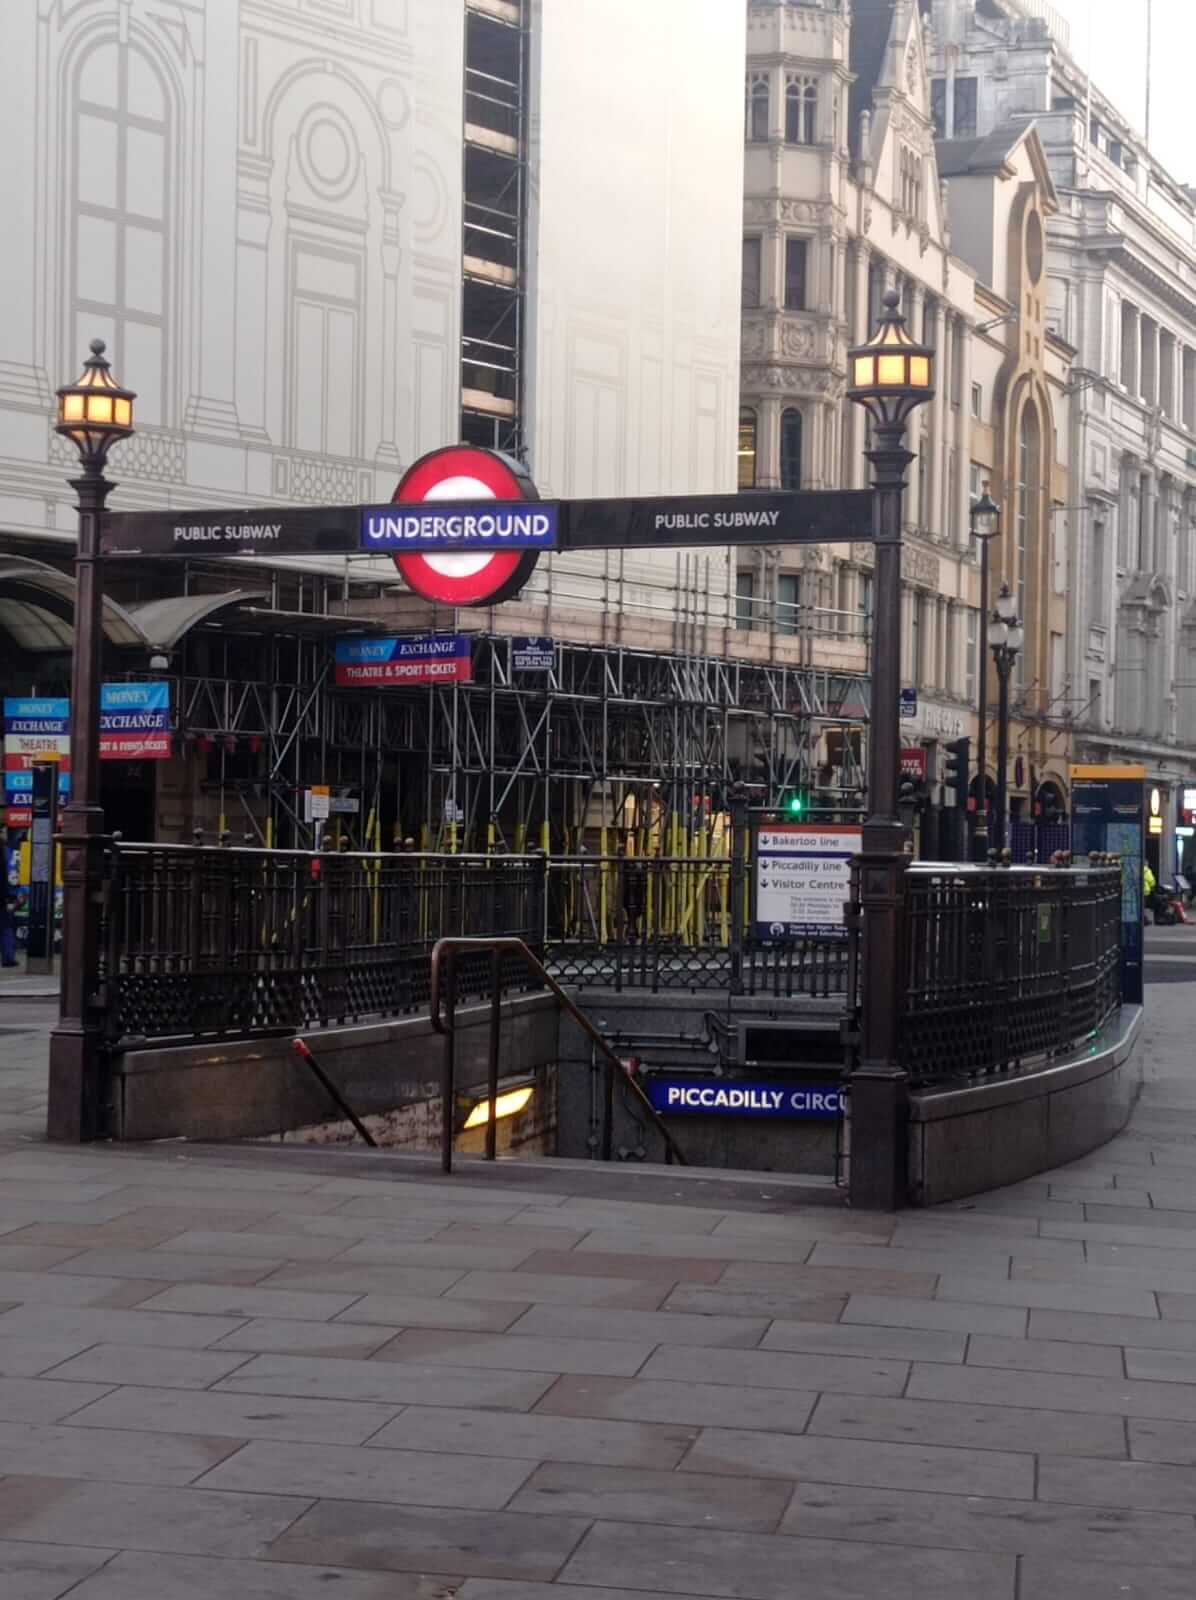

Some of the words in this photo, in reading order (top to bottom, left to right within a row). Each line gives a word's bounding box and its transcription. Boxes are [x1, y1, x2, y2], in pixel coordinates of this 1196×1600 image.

[368, 514, 550, 538] UNDERGROUND
[655, 513, 710, 529] PUBLIC
[713, 511, 780, 527] SUBWAY
[173, 526, 222, 541] PUBLIC
[225, 524, 281, 540] SUBWAY
[400, 642, 456, 655] EXCHANGE
[346, 667, 383, 678] THEATRE
[385, 667, 392, 677] &
[394, 665, 422, 677] SPORT
[425, 663, 456, 675] TICKETS
[106, 690, 148, 704] MONEY
[12, 720, 63, 731] EXCHANGE
[772, 836, 817, 846] Bakerloo
[820, 836, 840, 846] line
[772, 860, 820, 873] Piccadilly
[823, 861, 842, 871] line
[772, 879, 805, 889] Visitor
[808, 880, 845, 889] Centre
[667, 1087, 784, 1109] PICCADILLY
